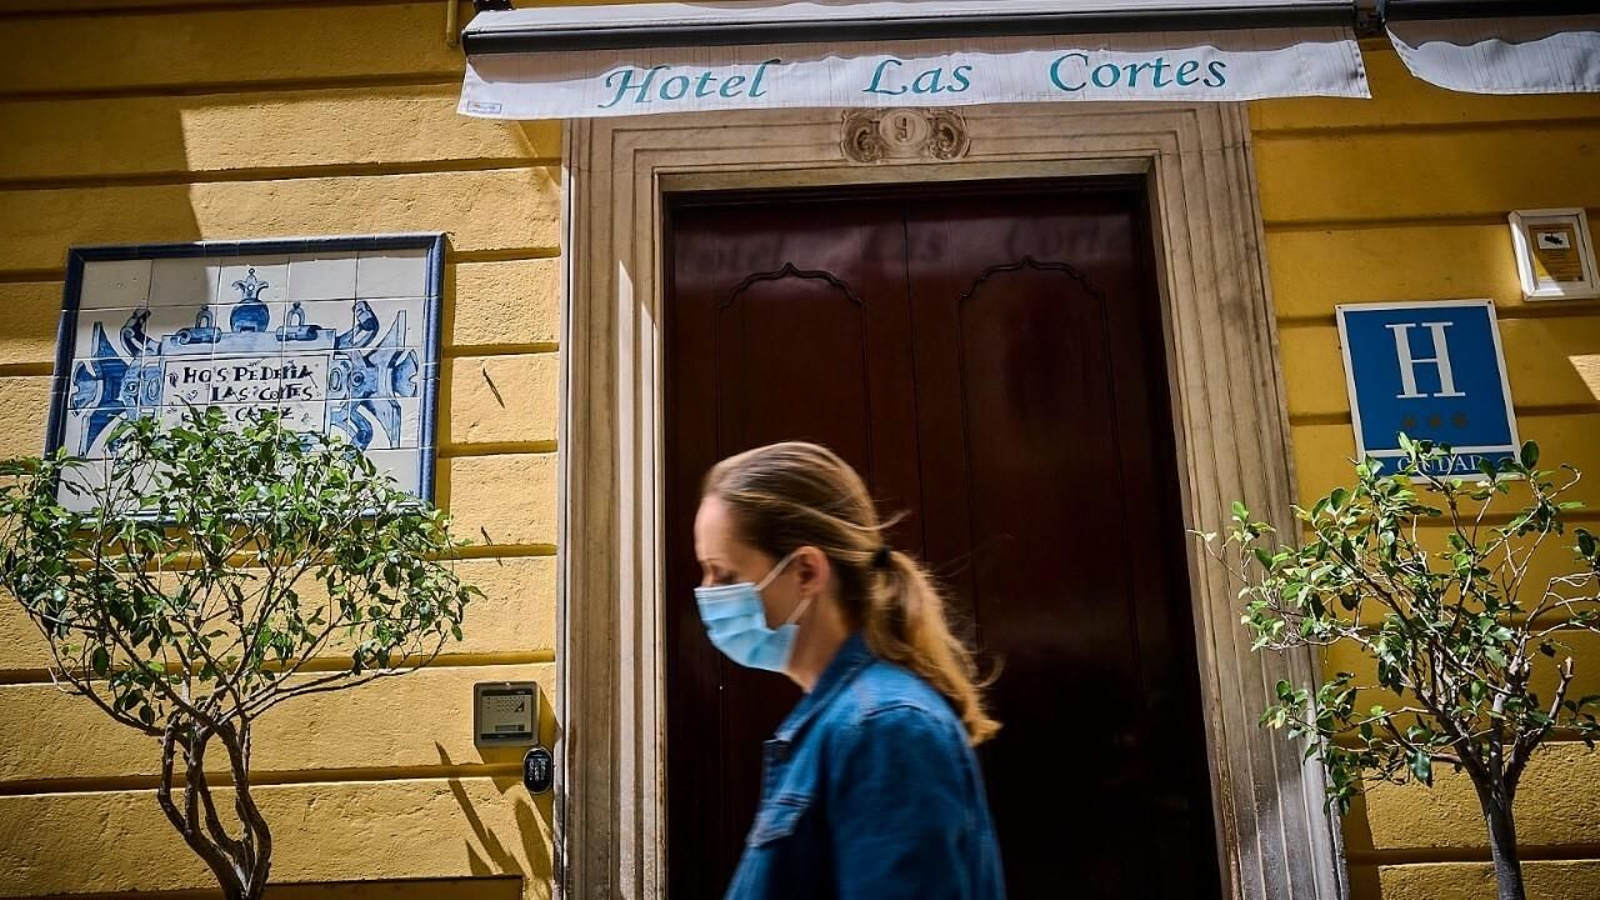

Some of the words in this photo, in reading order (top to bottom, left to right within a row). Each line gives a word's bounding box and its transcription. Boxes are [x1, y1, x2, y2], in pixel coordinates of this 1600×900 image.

[597, 57, 782, 109] Hotel
[862, 58, 973, 96] Las
[1049, 53, 1228, 92] Cortes
[1384, 321, 1467, 399] H
[211, 385, 249, 402] LAS
[1396, 454, 1483, 473] CUDAD
